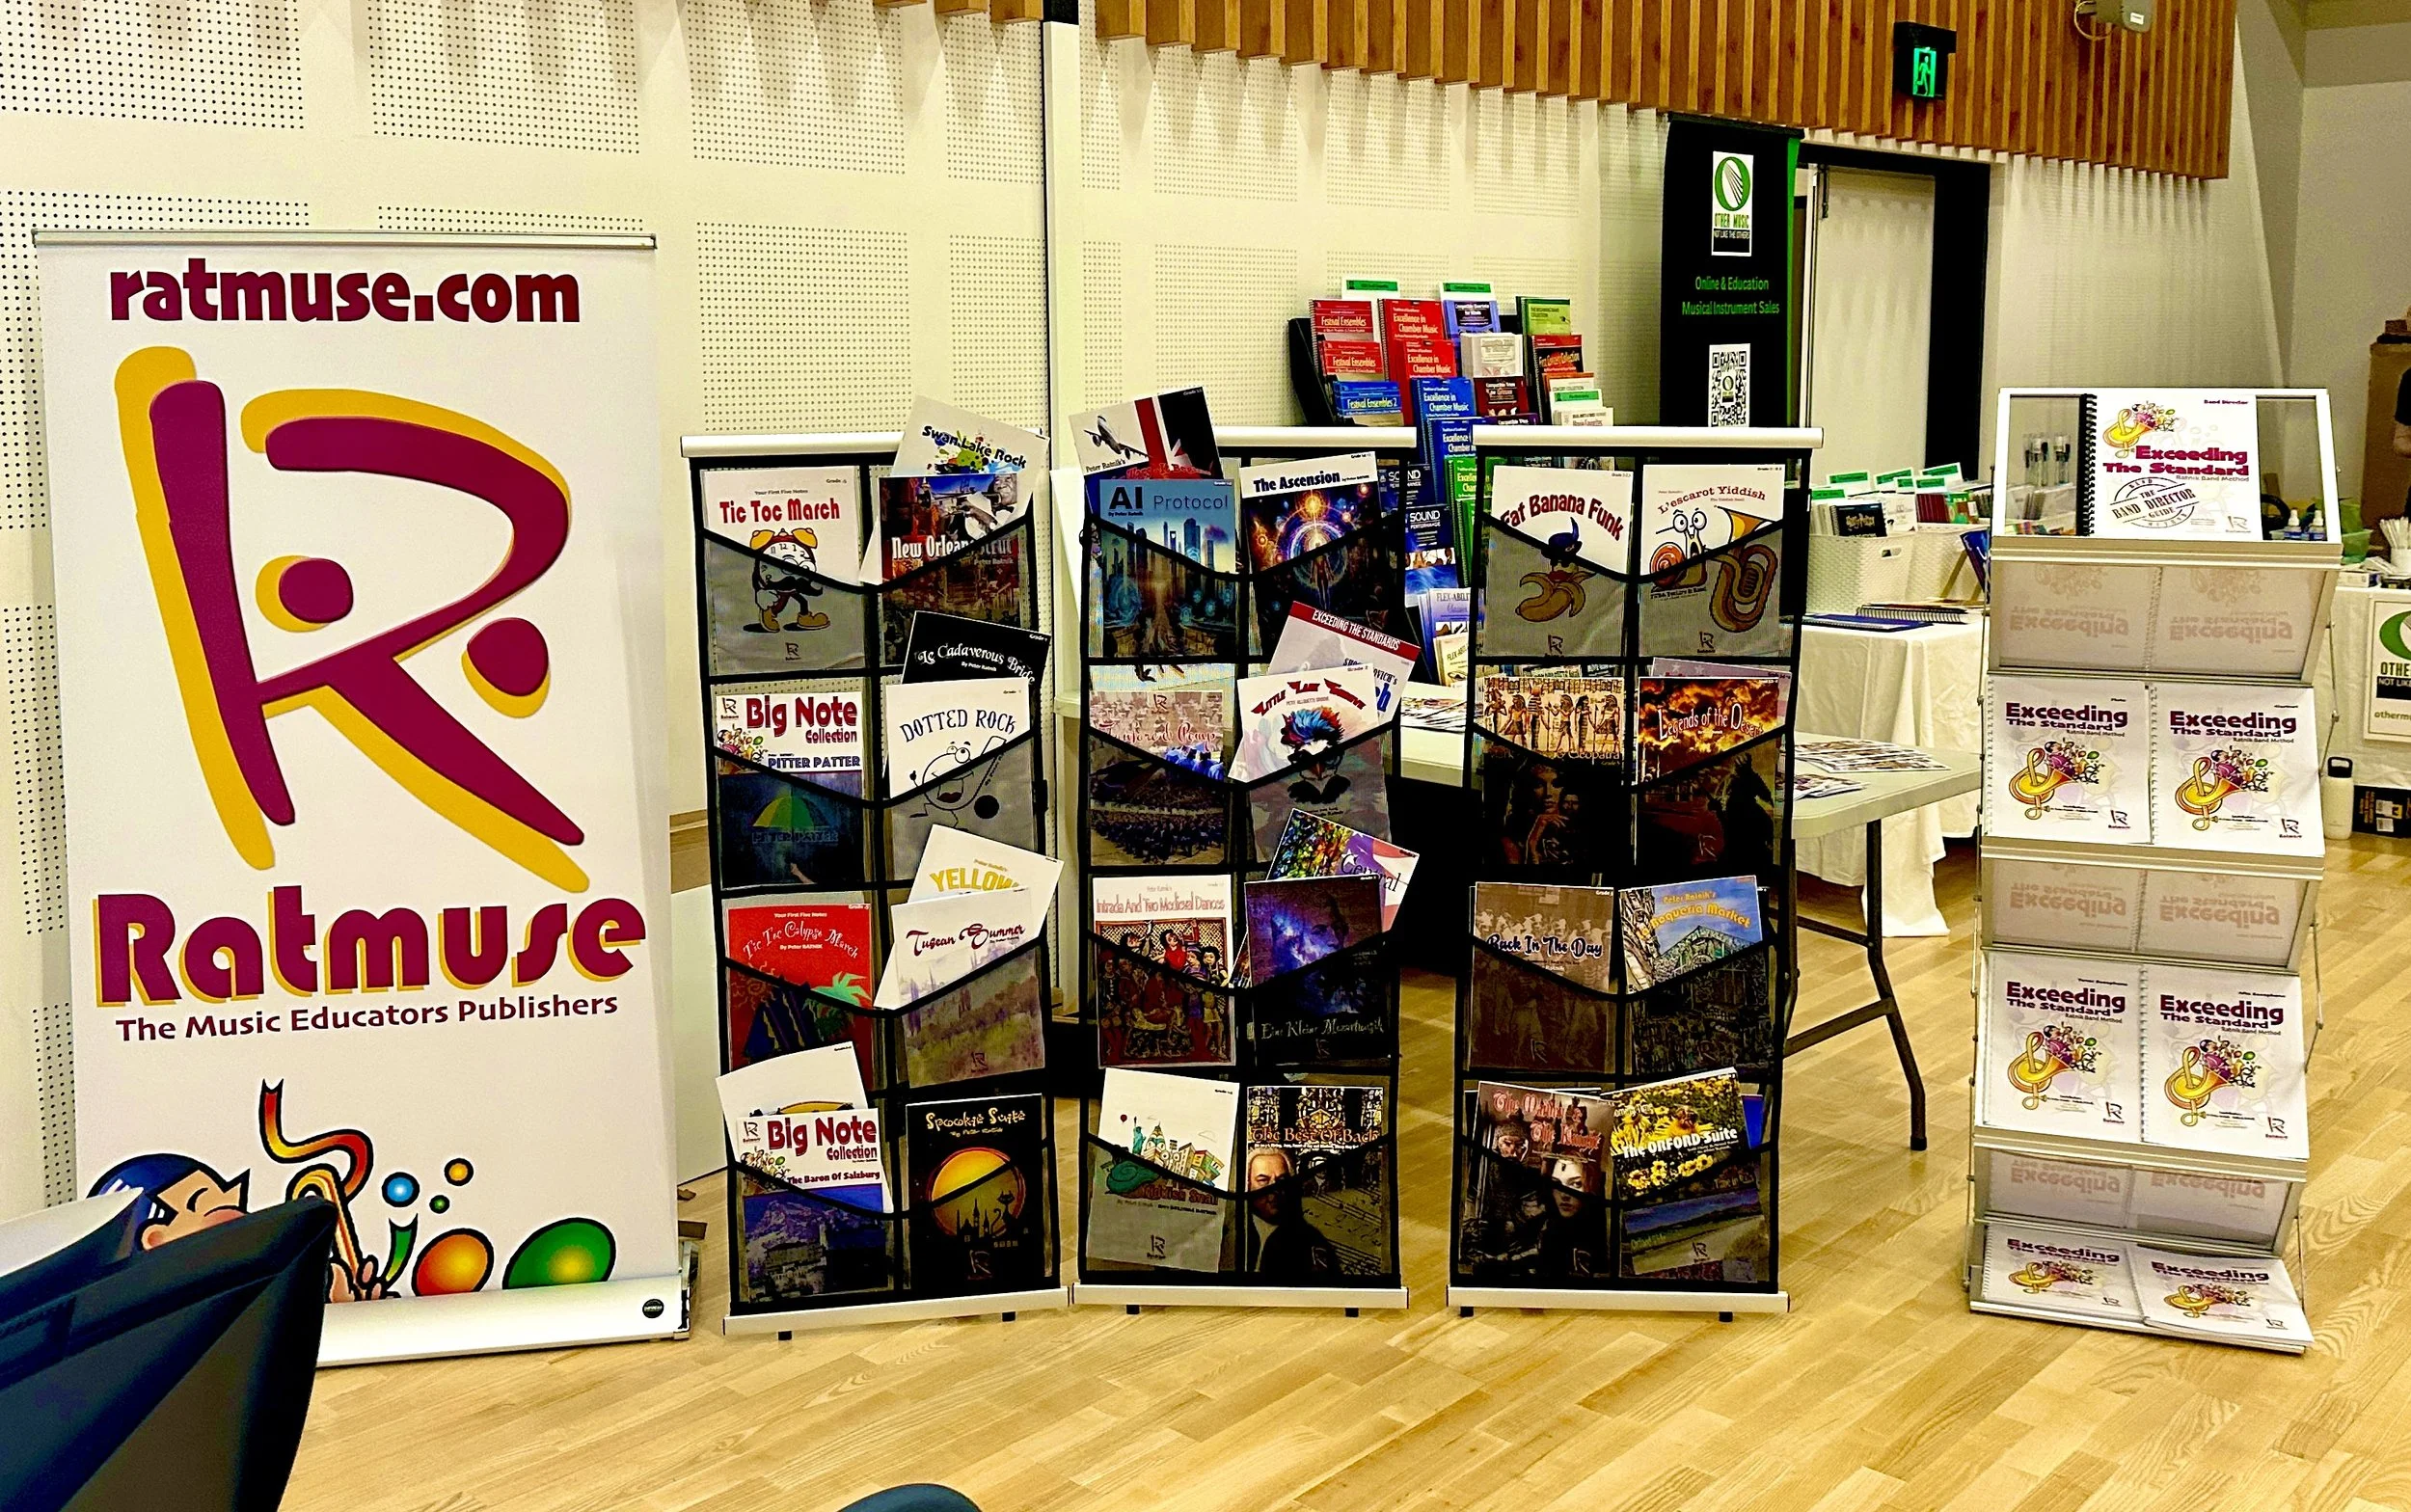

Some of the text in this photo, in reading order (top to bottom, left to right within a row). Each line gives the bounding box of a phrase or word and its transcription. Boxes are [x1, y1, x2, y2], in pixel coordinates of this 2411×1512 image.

[110, 257, 581, 323] ratmuse.com
[1695, 276, 1770, 290] Online & Education
[1682, 300, 1780, 315] Musical Instrument Sales
[922, 425, 1027, 470] Swan Lake Rock
[2135, 446, 2248, 465] Exceeding
[2103, 462, 2249, 476] The Standard
[1253, 471, 1341, 493] The Ascension
[719, 497, 840, 524] Tic Toc March
[1109, 486, 1228, 511] AI Protocol
[1658, 485, 1766, 515] L'escarot Yiddish
[2111, 503, 2142, 520] BAND
[2144, 488, 2196, 510] DIRECTOR
[1410, 510, 1440, 523] SOUND
[1500, 494, 1624, 542] Fat Banana Funk
[891, 536, 923, 560] New
[1312, 608, 1401, 651] EXCEEDING THE STANDARDS
[936, 643, 1004, 664] Cadaverous
[2378, 678, 2395, 687] NOT
[746, 695, 857, 738] Big Note
[900, 709, 1017, 742] DOTTED ROCK
[1657, 708, 1698, 741] Legends
[1701, 706, 1712, 726] of
[1714, 708, 1727, 728] the
[2006, 702, 2127, 728] Exceeding
[2006, 718, 2113, 731] The Standard
[2170, 711, 2297, 734] Exceeding
[805, 727, 857, 744] Collection
[2206, 728, 2281, 738] Standard
[768, 755, 861, 769] PITTER PATTER
[1706, 903, 1750, 929] Market
[93, 885, 646, 1009] Ratmuse
[743, 940, 762, 960] Tic
[825, 929, 858, 958] March
[907, 923, 1026, 957] Tuscan Summer
[1524, 934, 1540, 955] In
[1542, 935, 1568, 958] The
[1570, 936, 1604, 958] Day
[2007, 981, 2126, 1013] Exceeding
[2007, 998, 2111, 1017] The Standard
[116, 993, 618, 1041] The Music Educators Publishers
[2160, 994, 2284, 1026] Exceeding
[2160, 1012, 2268, 1029] The Standard
[926, 1107, 1026, 1131] Spookie Suite
[767, 1116, 877, 1156] Big Note
[1253, 1128, 1280, 1143] The
[1284, 1127, 1317, 1142] Best
[1624, 1145, 1645, 1159] The
[1647, 1135, 1701, 1154] ORFORD
[1700, 1126, 1738, 1145] Suite
[826, 1145, 877, 1161] Collection
[787, 1171, 880, 1185] The Baron Of Salzburg
[2007, 1238, 2120, 1263] Exceeding
[2151, 1260, 2269, 1282] Exceeding
